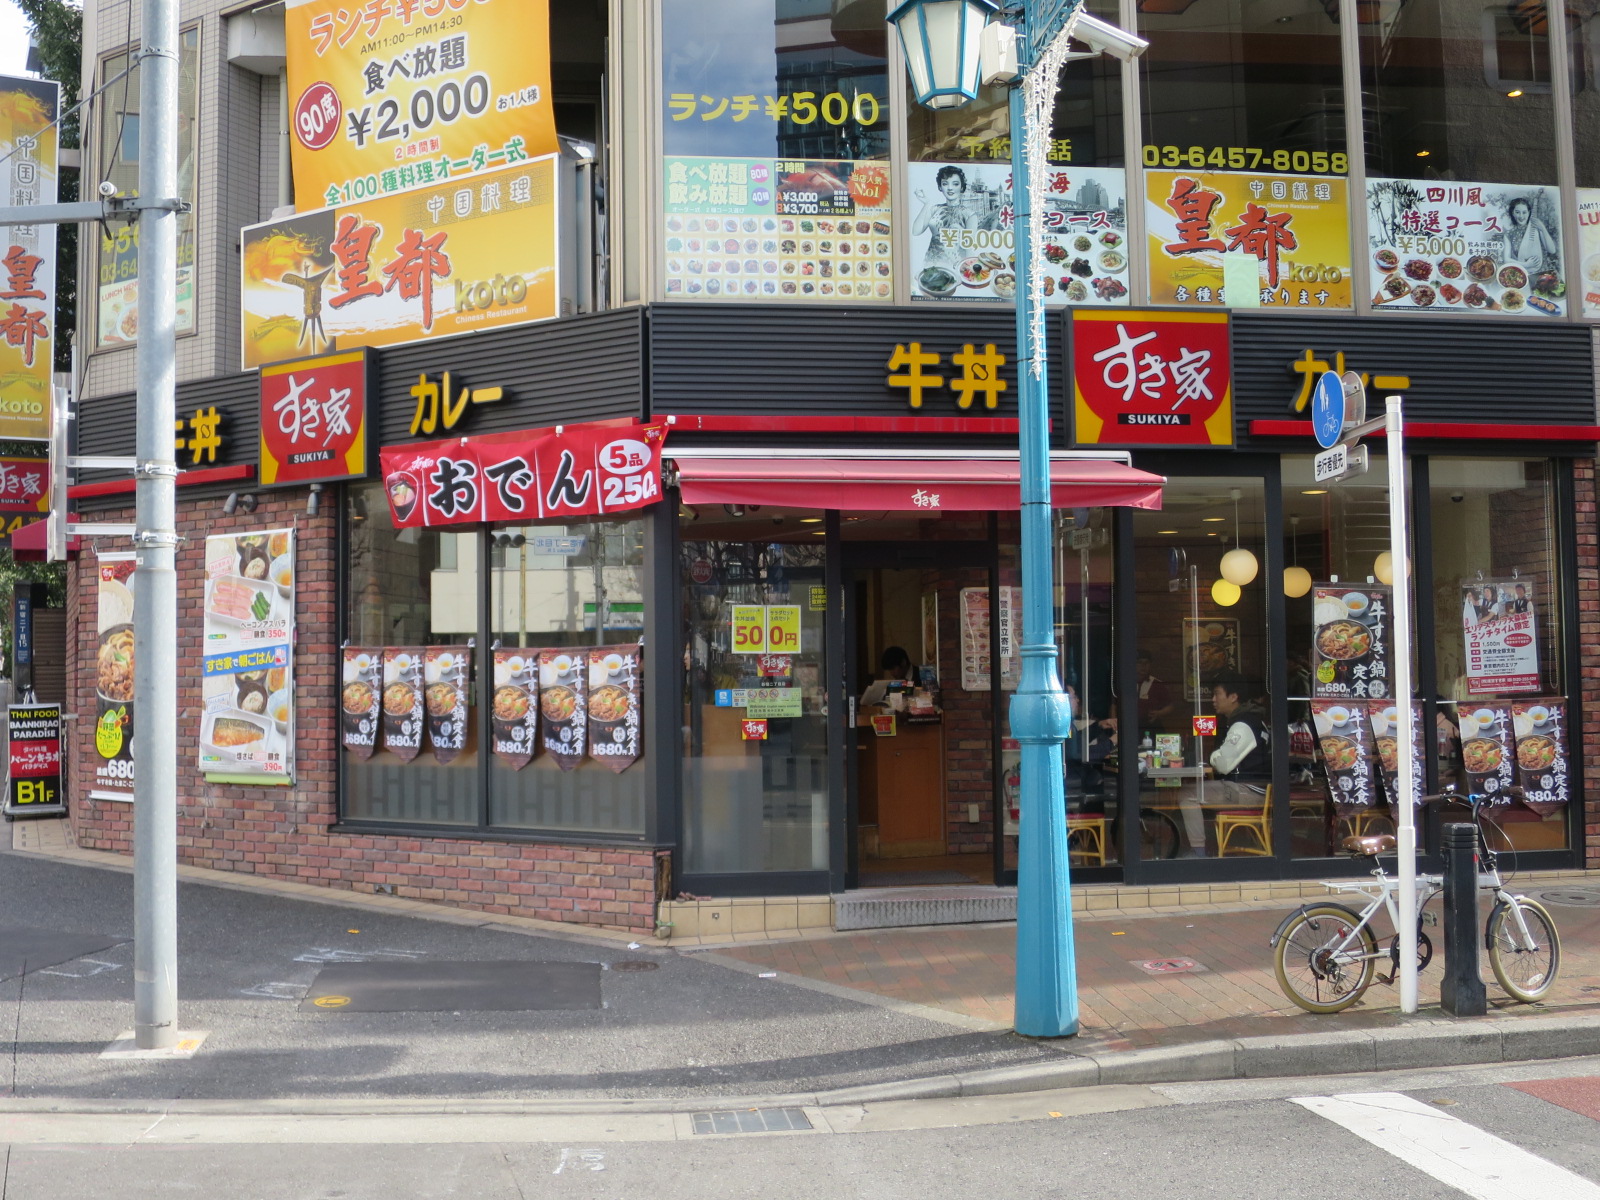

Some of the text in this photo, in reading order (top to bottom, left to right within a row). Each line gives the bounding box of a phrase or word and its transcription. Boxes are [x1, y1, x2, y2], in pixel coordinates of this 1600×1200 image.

[363, 36, 466, 95] 食べ放題
[348, 75, 489, 146] ¥2,000
[497, 90, 538, 110] お1人様
[668, 91, 880, 126] ランチ¥500
[300, 93, 337, 141] 90席
[961, 136, 1072, 161] 予約話
[1142, 145, 1348, 173] 03-6457-8058
[668, 162, 747, 184] 食べ放題
[775, 162, 805, 174] 2時間
[427, 177, 531, 223] 中国料理
[668, 184, 747, 205] 飲み放題
[1250, 181, 1330, 200] 中国料理
[1427, 187, 1486, 207] 四川風
[1165, 178, 1298, 288] 皇都
[1401, 211, 1502, 233] 特選コース
[1398, 236, 1465, 257] ¥5,000
[329, 215, 452, 330] 皇都
[1288, 262, 1342, 283] koto
[454, 272, 528, 312] koto
[0, 246, 48, 366] 皇都
[486, 305, 527, 319] Restaurant
[888, 342, 1008, 409] 牛丼
[1093, 323, 1214, 411] すき家
[273, 374, 351, 448] すき家
[409, 371, 503, 435] カレー
[1127, 414, 1181, 426] SUKIYA
[293, 451, 329, 464] SUKIYA
[609, 445, 643, 469] 5品
[429, 449, 592, 518] おでん
[1000, 600, 1010, 655] 警察官立寄所
[9, 720, 59, 729] BAANKIRAO
[11, 710, 58, 719] THAI FOOD
[17, 780, 54, 804] B1F
